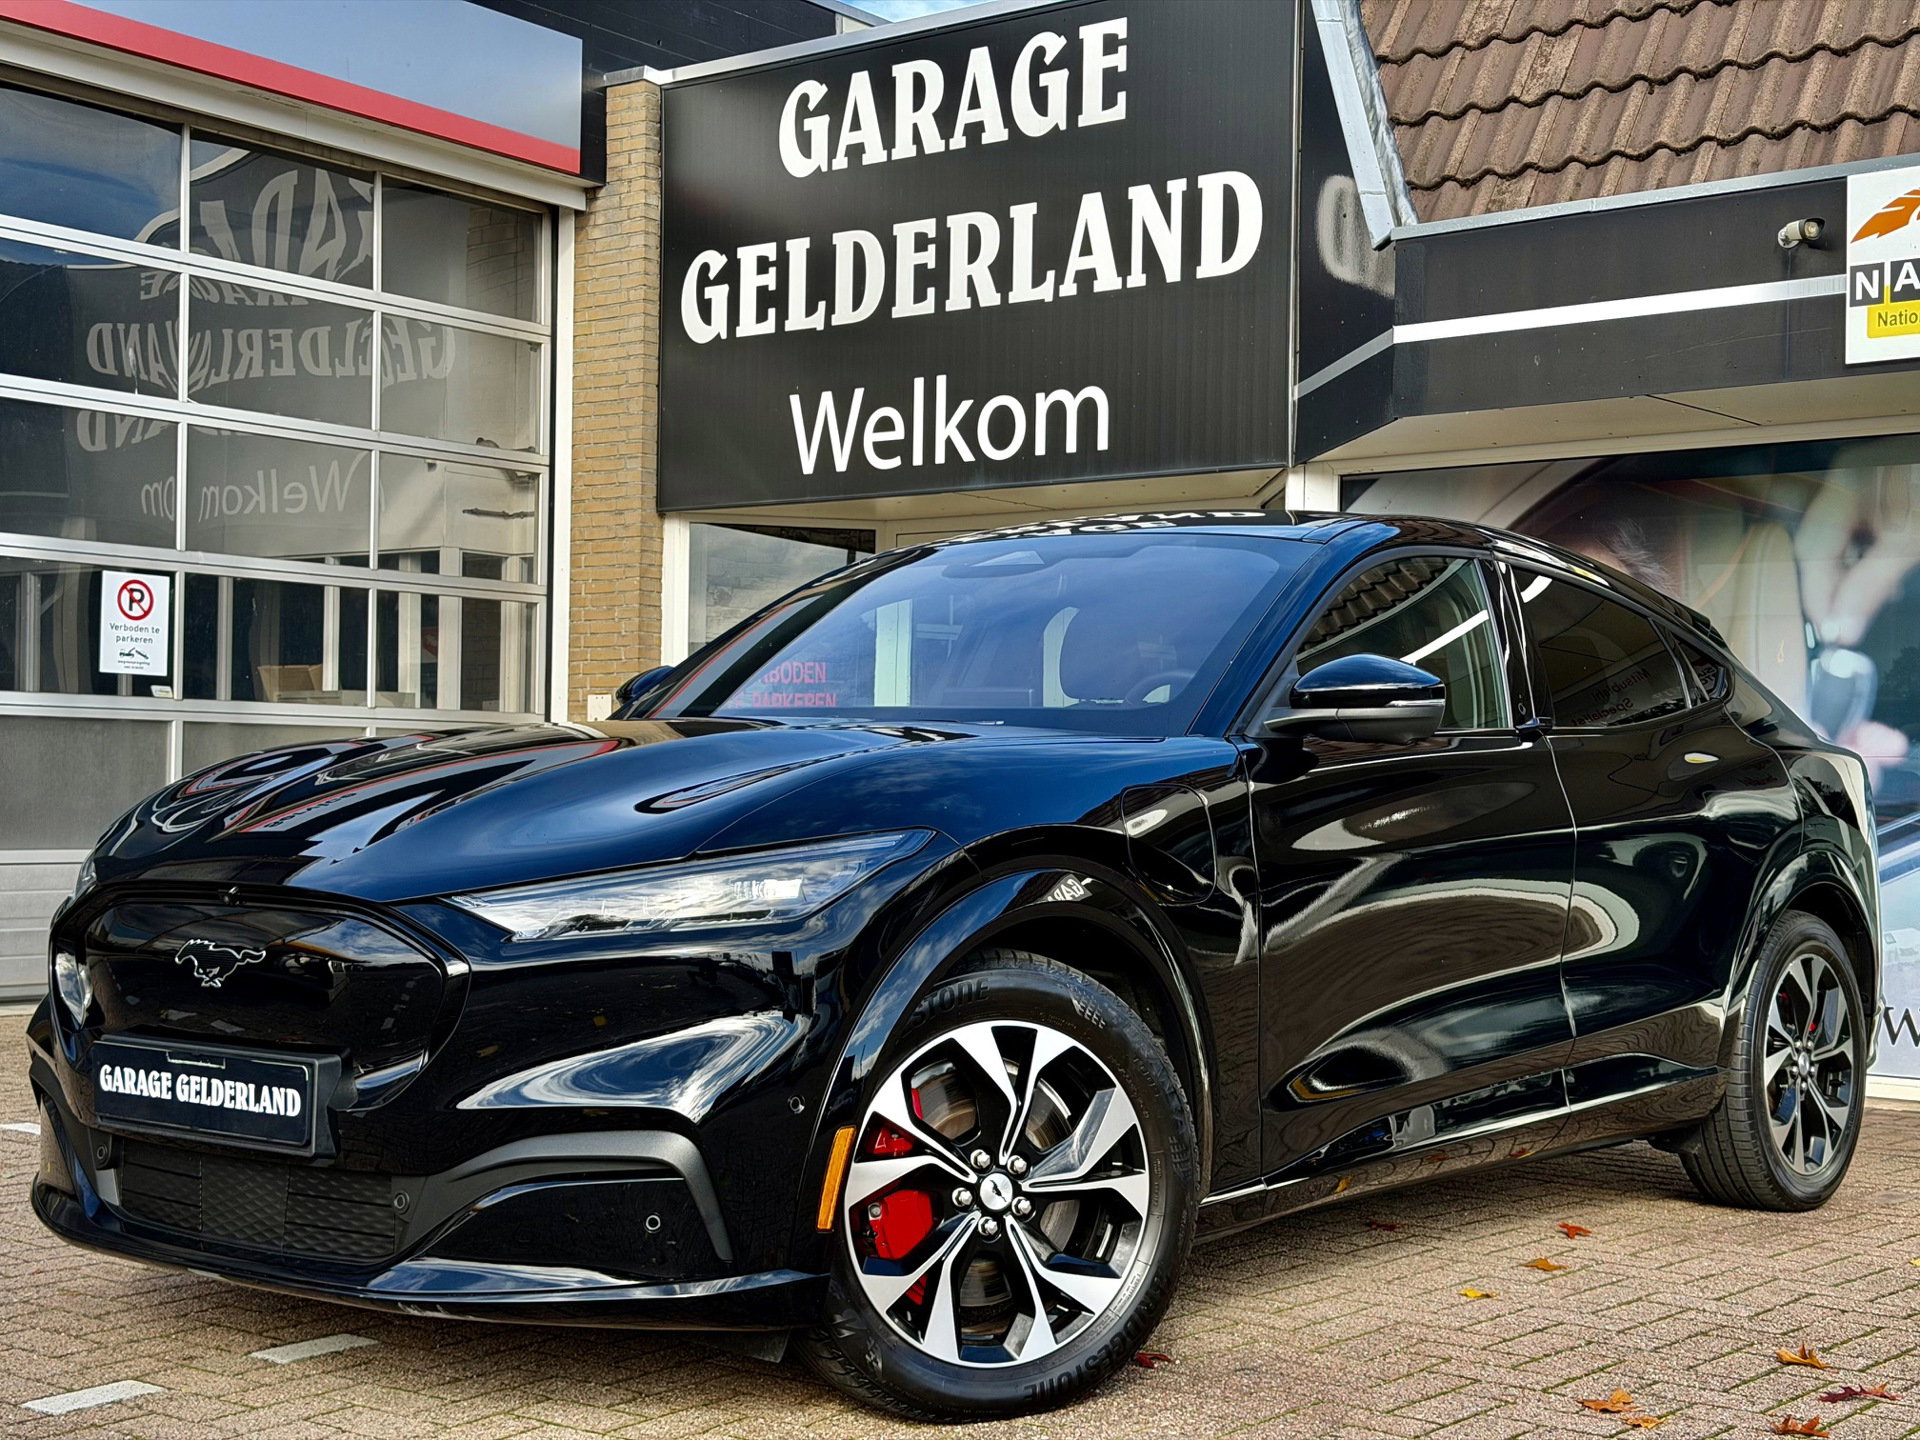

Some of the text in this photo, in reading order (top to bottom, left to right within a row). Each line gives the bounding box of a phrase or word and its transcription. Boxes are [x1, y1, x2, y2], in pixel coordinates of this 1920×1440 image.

[778, 17, 1128, 178] GARAGE
[681, 170, 1264, 345] GELDERLAND
[1877, 310, 1920, 327] Natio
[788, 374, 1110, 475] Welkom
[109, 623, 160, 634] Verboden te
[115, 635, 153, 644] parkeren
[100, 1064, 302, 1118] GARAGE GELDERLAND
